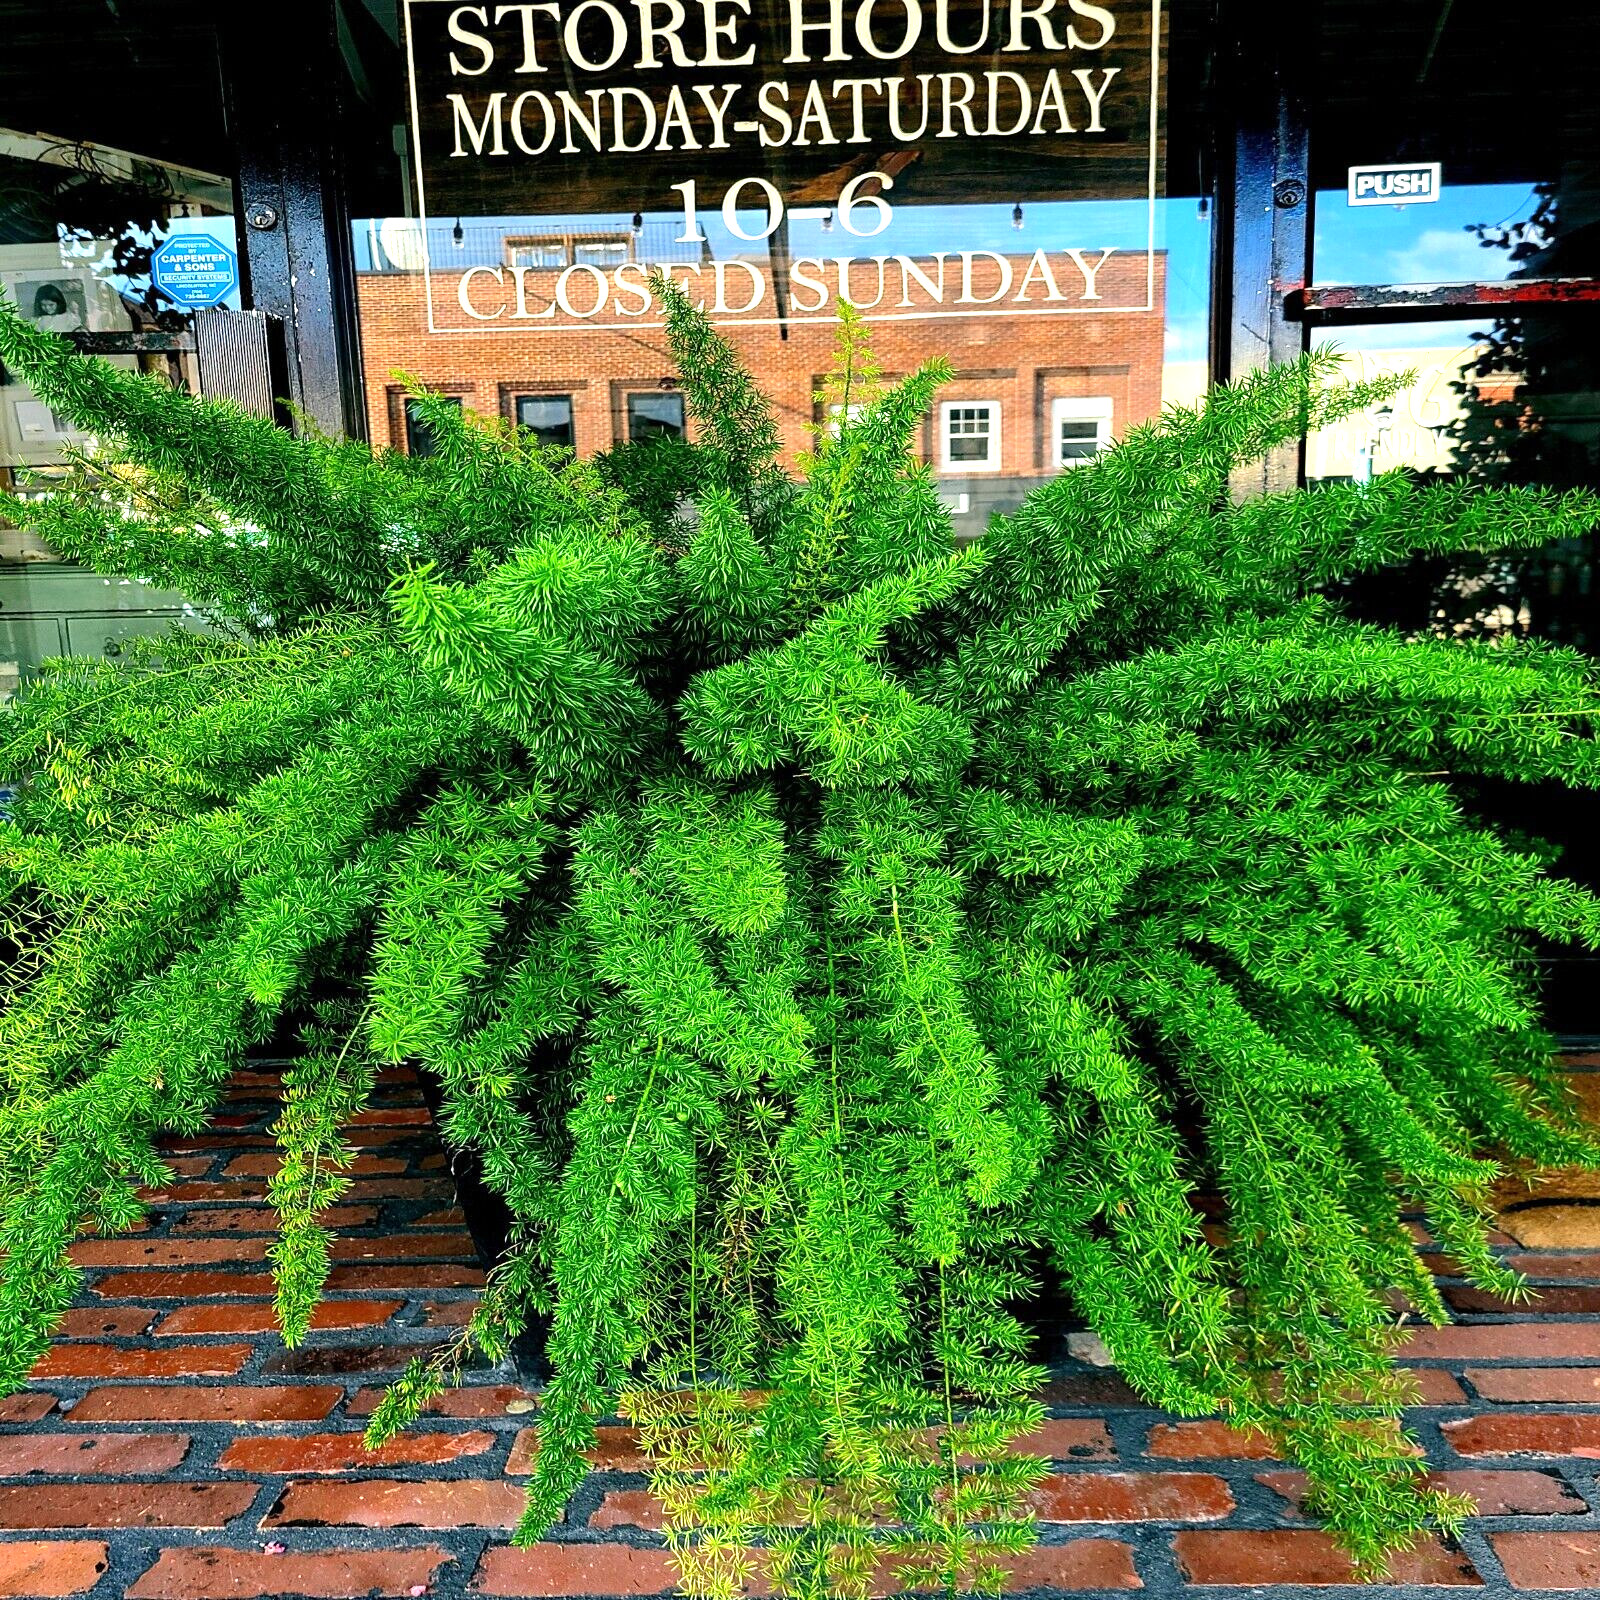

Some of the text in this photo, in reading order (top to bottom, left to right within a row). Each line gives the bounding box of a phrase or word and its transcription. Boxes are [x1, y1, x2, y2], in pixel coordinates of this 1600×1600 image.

[447, 0, 1117, 77] STORE HOURS
[445, 67, 1122, 157] MONDAY-SATURDAY
[670, 171, 895, 244] 10-6
[1357, 173, 1430, 196] PUSH
[161, 254, 226, 263] CARPENTER
[184, 263, 215, 271] SONS
[789, 247, 1121, 312] SUNDAY
